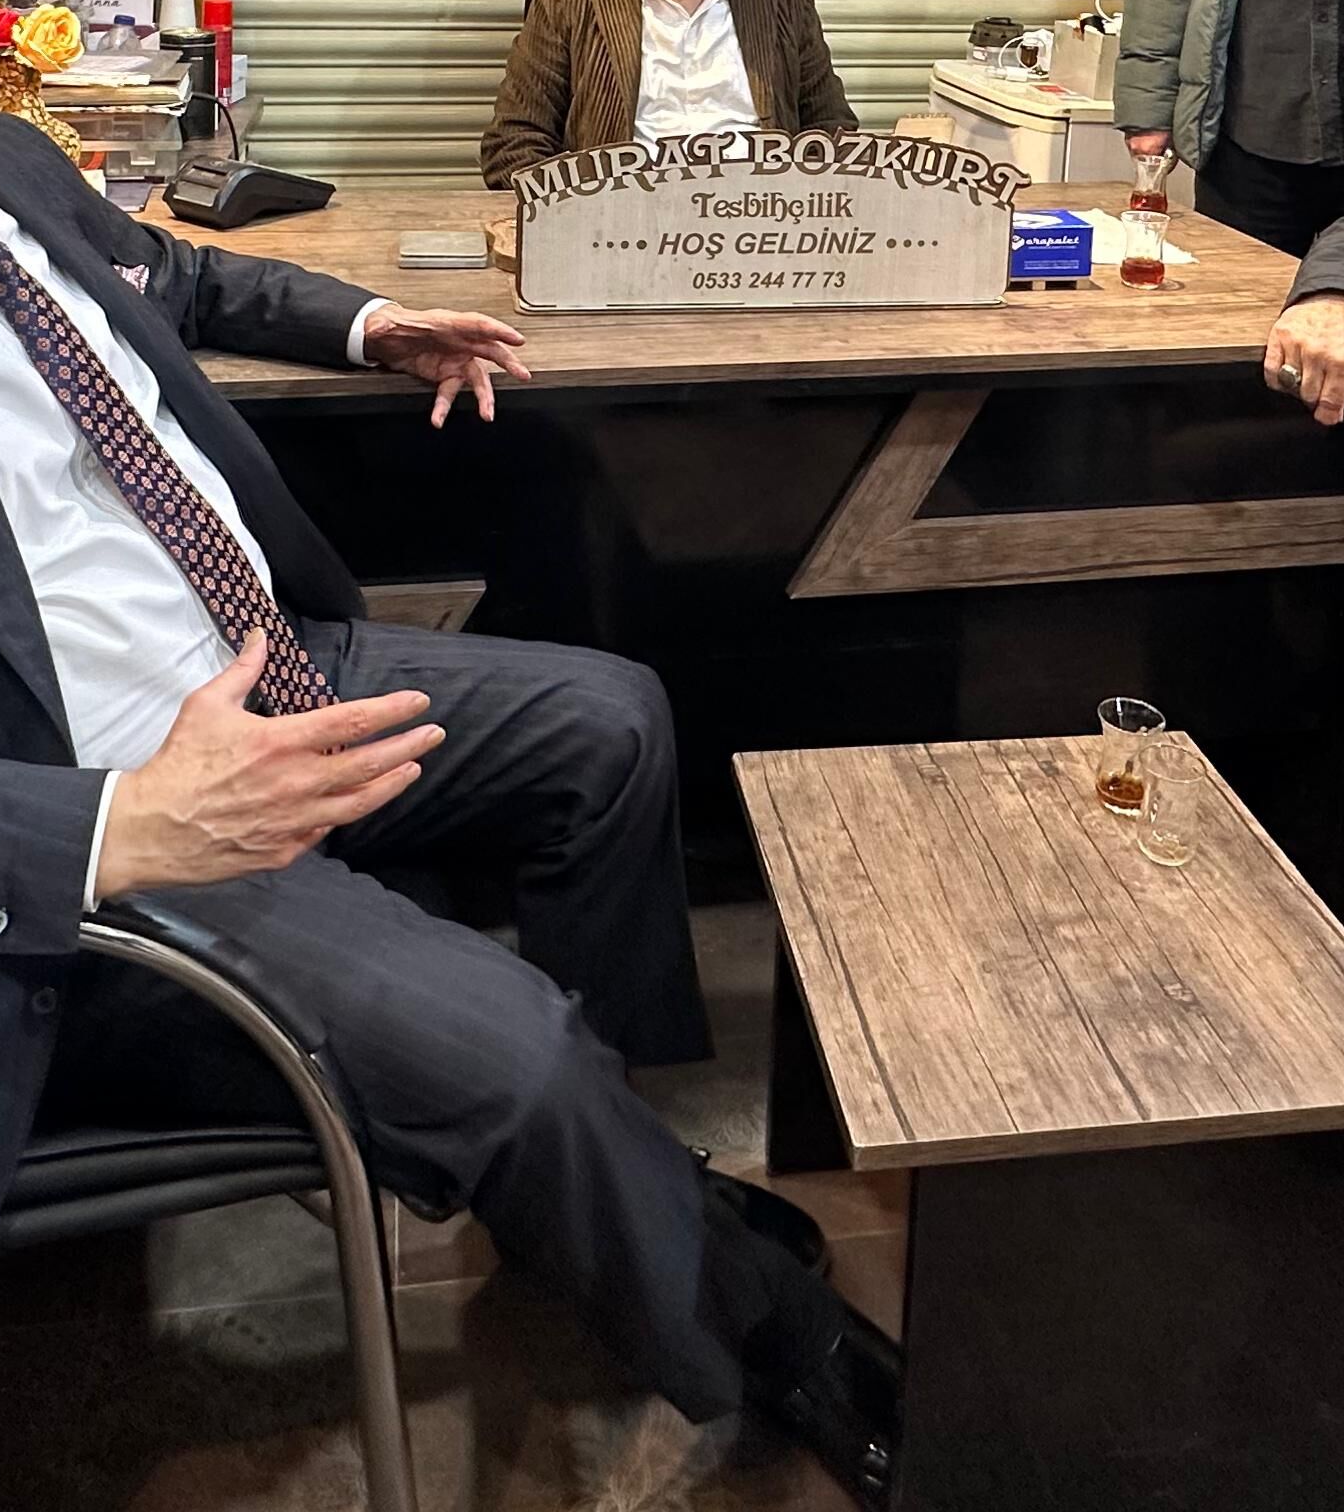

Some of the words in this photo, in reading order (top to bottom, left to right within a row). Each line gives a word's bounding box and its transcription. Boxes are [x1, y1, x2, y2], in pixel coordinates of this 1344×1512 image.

[513, 133, 734, 222] MURAT
[750, 130, 1032, 210] BOZKURT
[691, 192, 854, 224] Tesbihçilik
[657, 232, 725, 260] HOŞ
[734, 227, 876, 255] GELDİNİZ
[692, 271, 742, 289] 0533
[748, 271, 786, 289] 244
[792, 271, 817, 288] 77
[822, 271, 846, 288] 73
